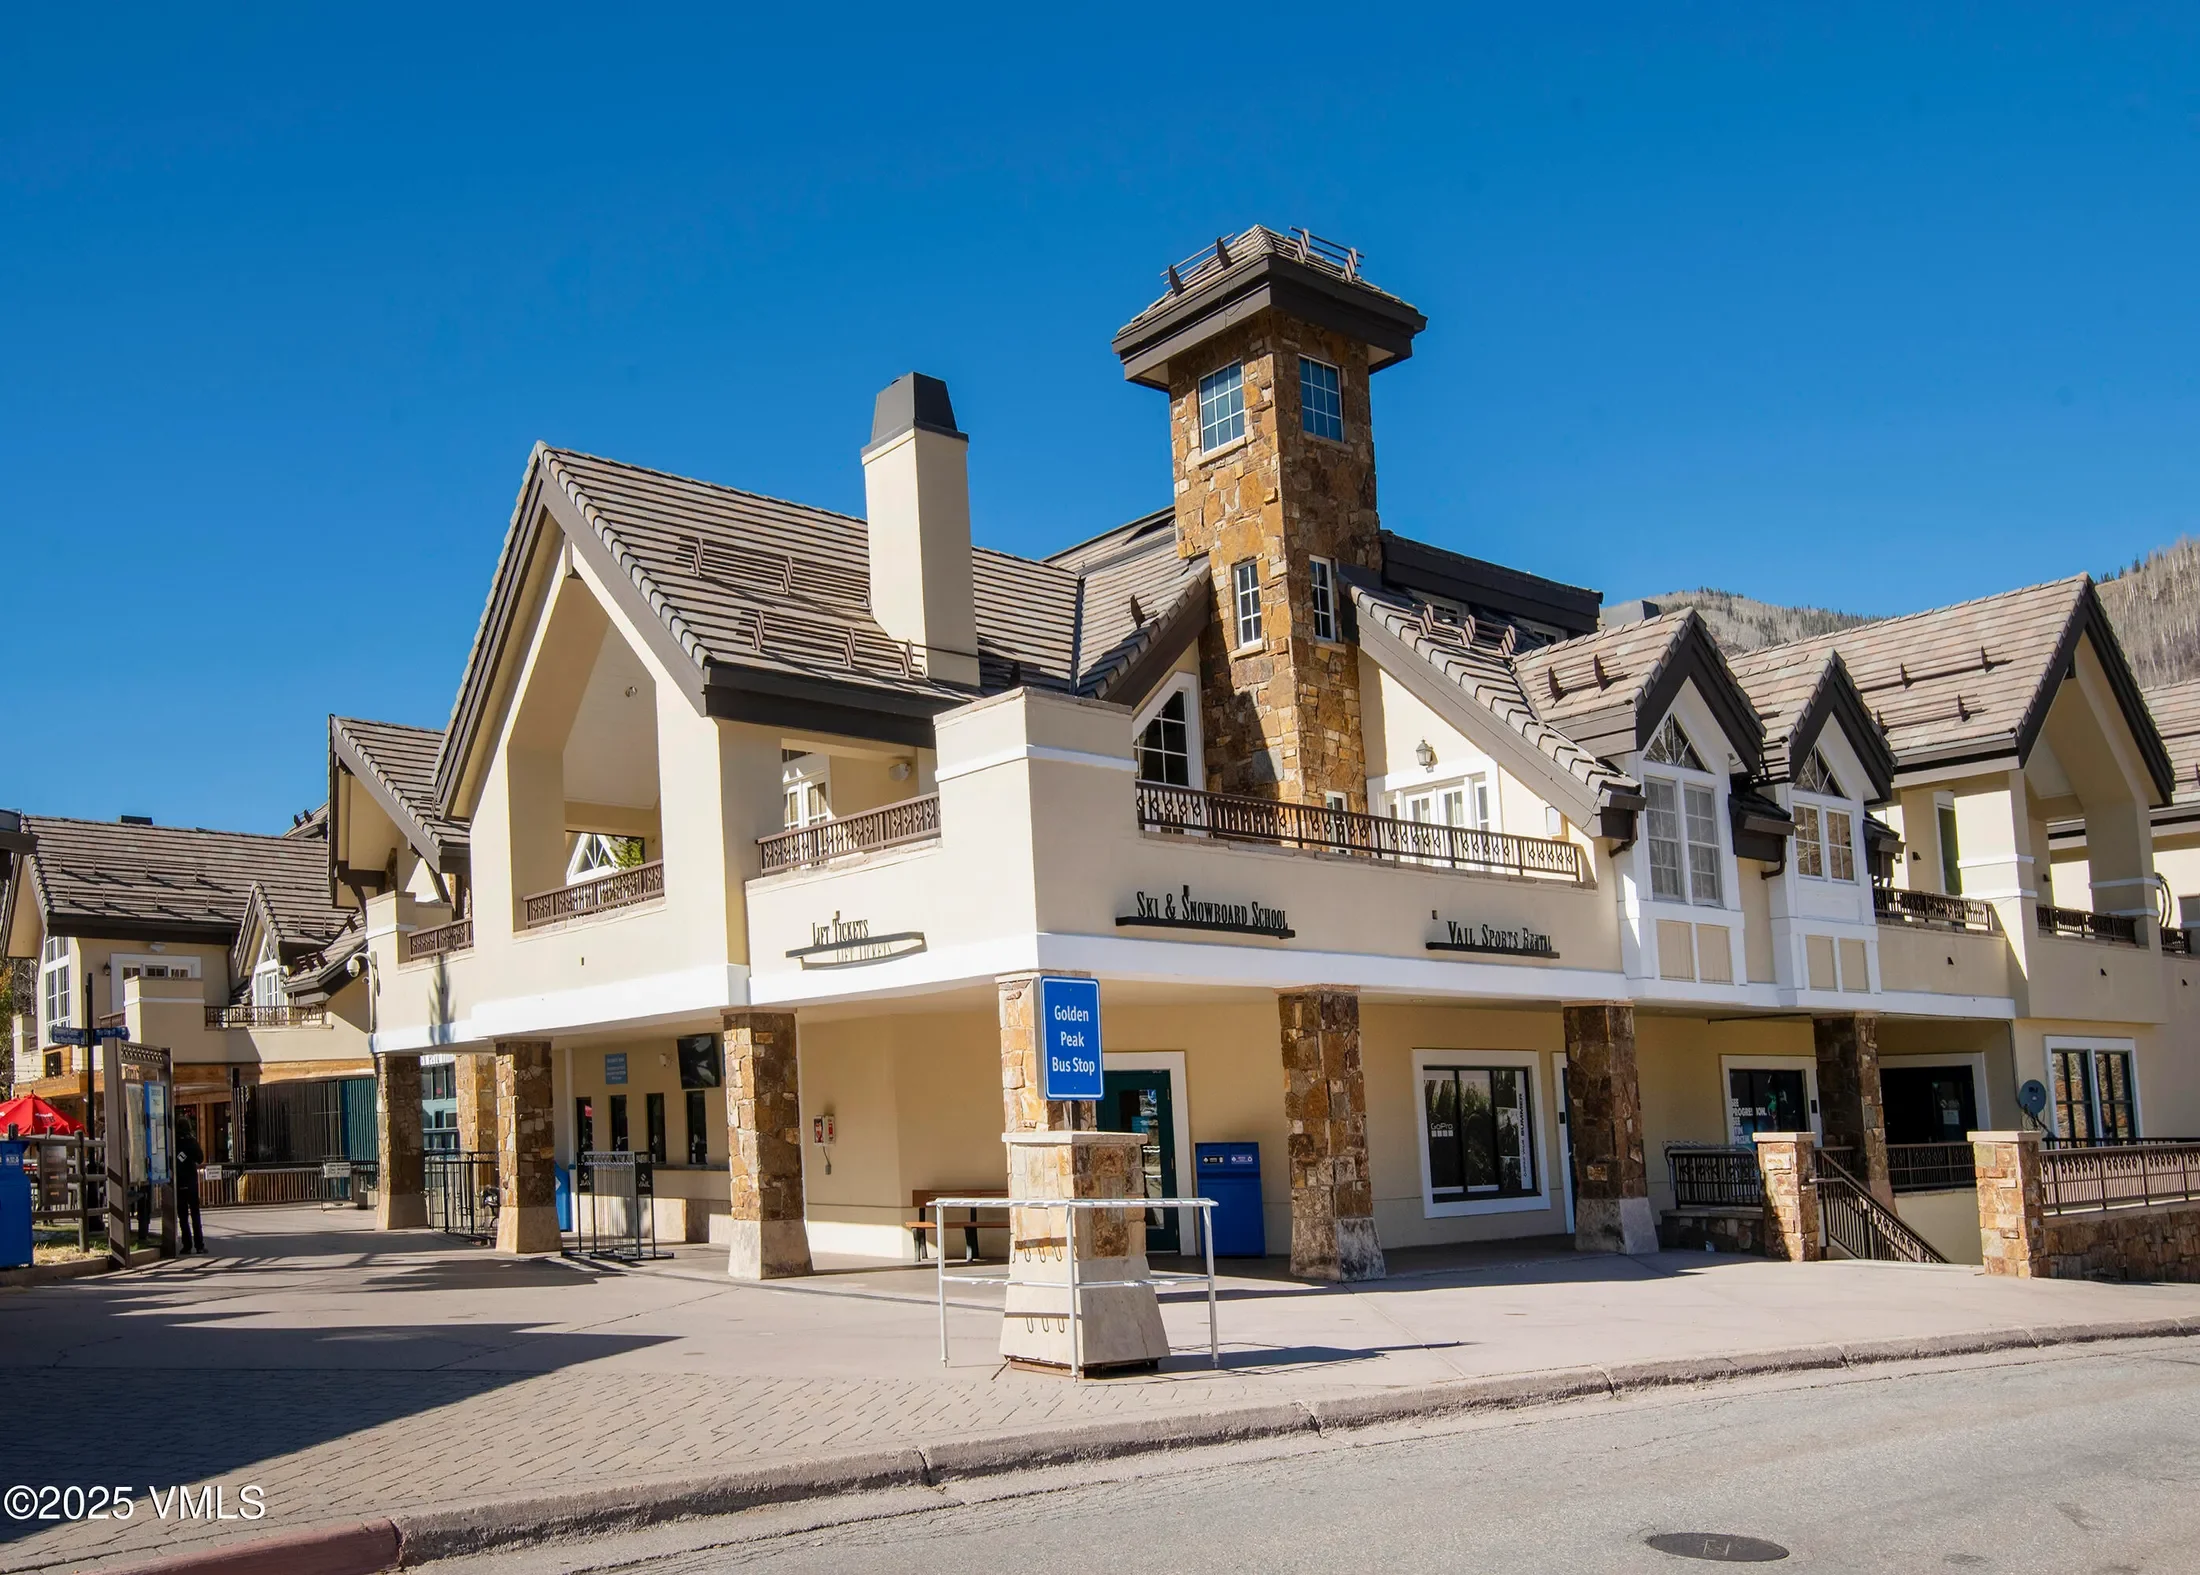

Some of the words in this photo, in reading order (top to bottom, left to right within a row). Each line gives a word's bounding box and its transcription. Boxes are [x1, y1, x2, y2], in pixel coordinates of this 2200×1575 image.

[1136, 891, 1159, 919] SKI
[1165, 893, 1176, 920] &
[1182, 895, 1248, 925] SNOWBOARD
[1251, 901, 1289, 930] SCHOOL
[812, 922, 830, 945] LIFT
[832, 919, 869, 942] TICKETS
[1447, 921, 1476, 945] VAIL
[1481, 924, 1519, 948] SPORTS
[1522, 928, 1552, 951] RENTAL
[1054, 1005, 1089, 1022] Golden
[1060, 1031, 1085, 1048] Peak
[1052, 1056, 1071, 1073] Bus
[1072, 1057, 1095, 1076] Stop
[1430, 1122, 1454, 1131] GoPro
